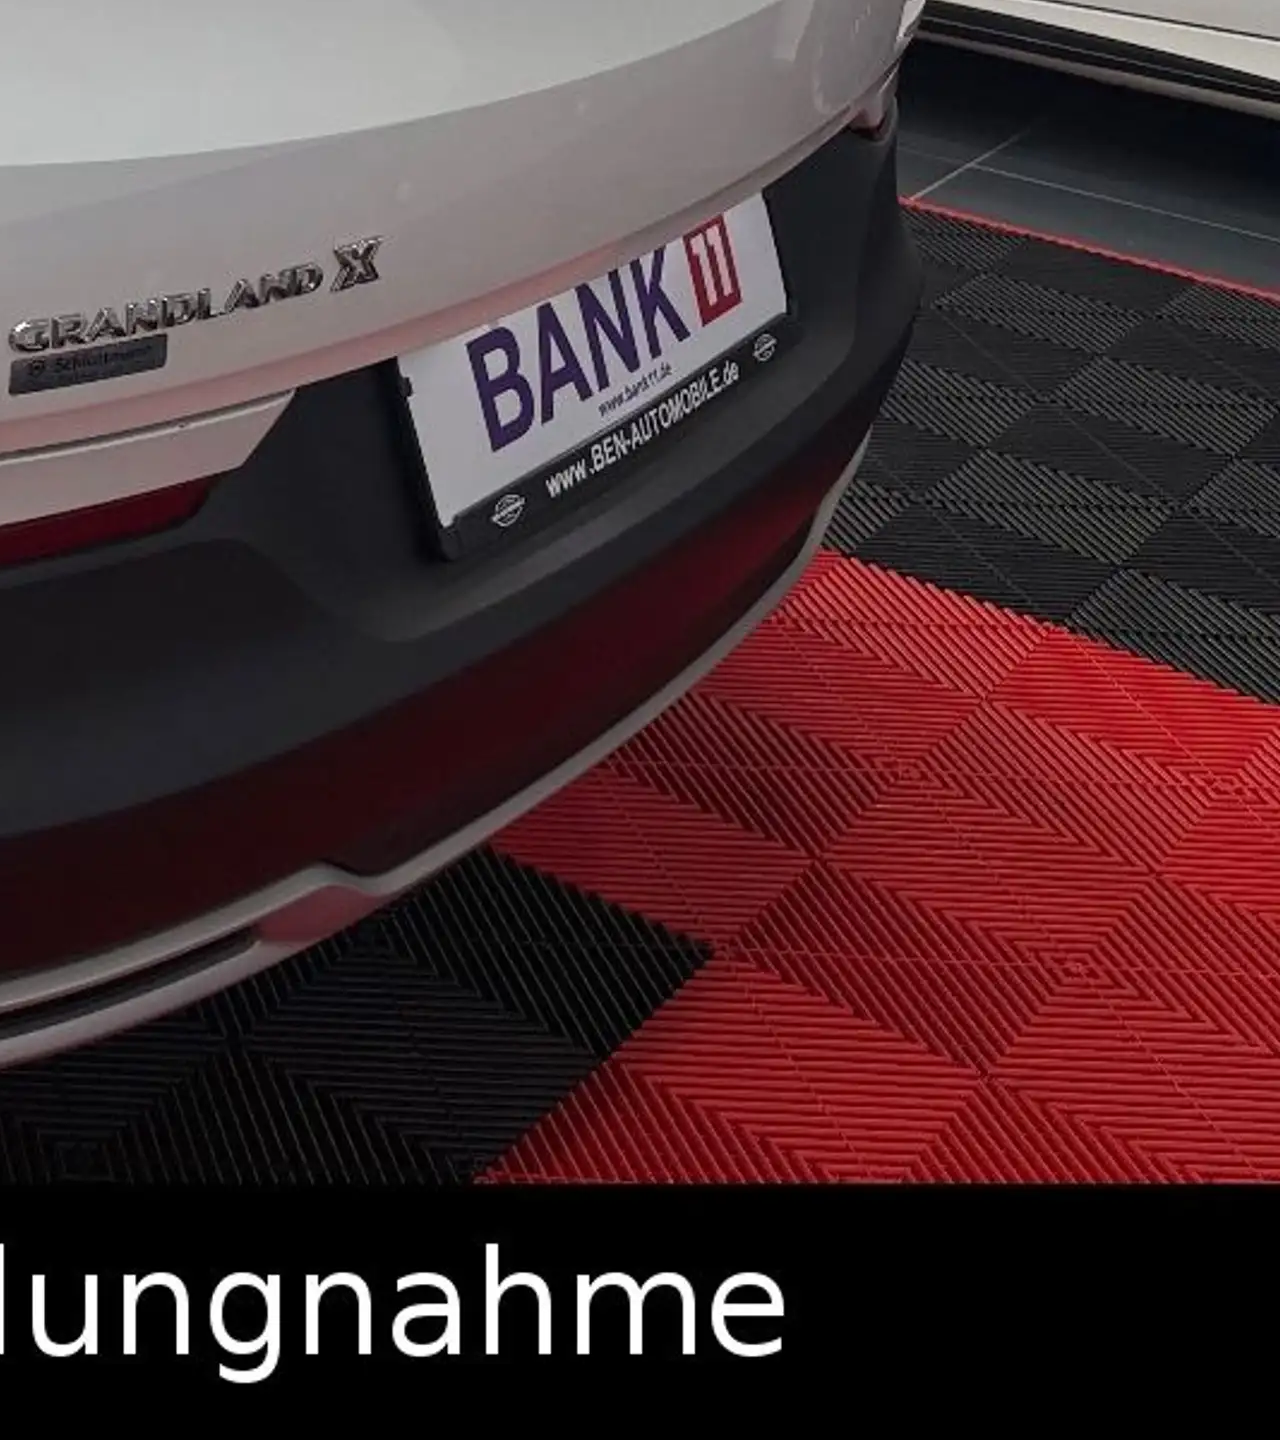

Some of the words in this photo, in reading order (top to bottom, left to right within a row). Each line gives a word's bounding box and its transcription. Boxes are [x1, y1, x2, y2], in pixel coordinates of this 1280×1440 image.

[7, 262, 325, 353] GRANDLAND
[330, 234, 383, 292] X
[465, 244, 692, 454] BANK
[687, 219, 738, 314] 11
